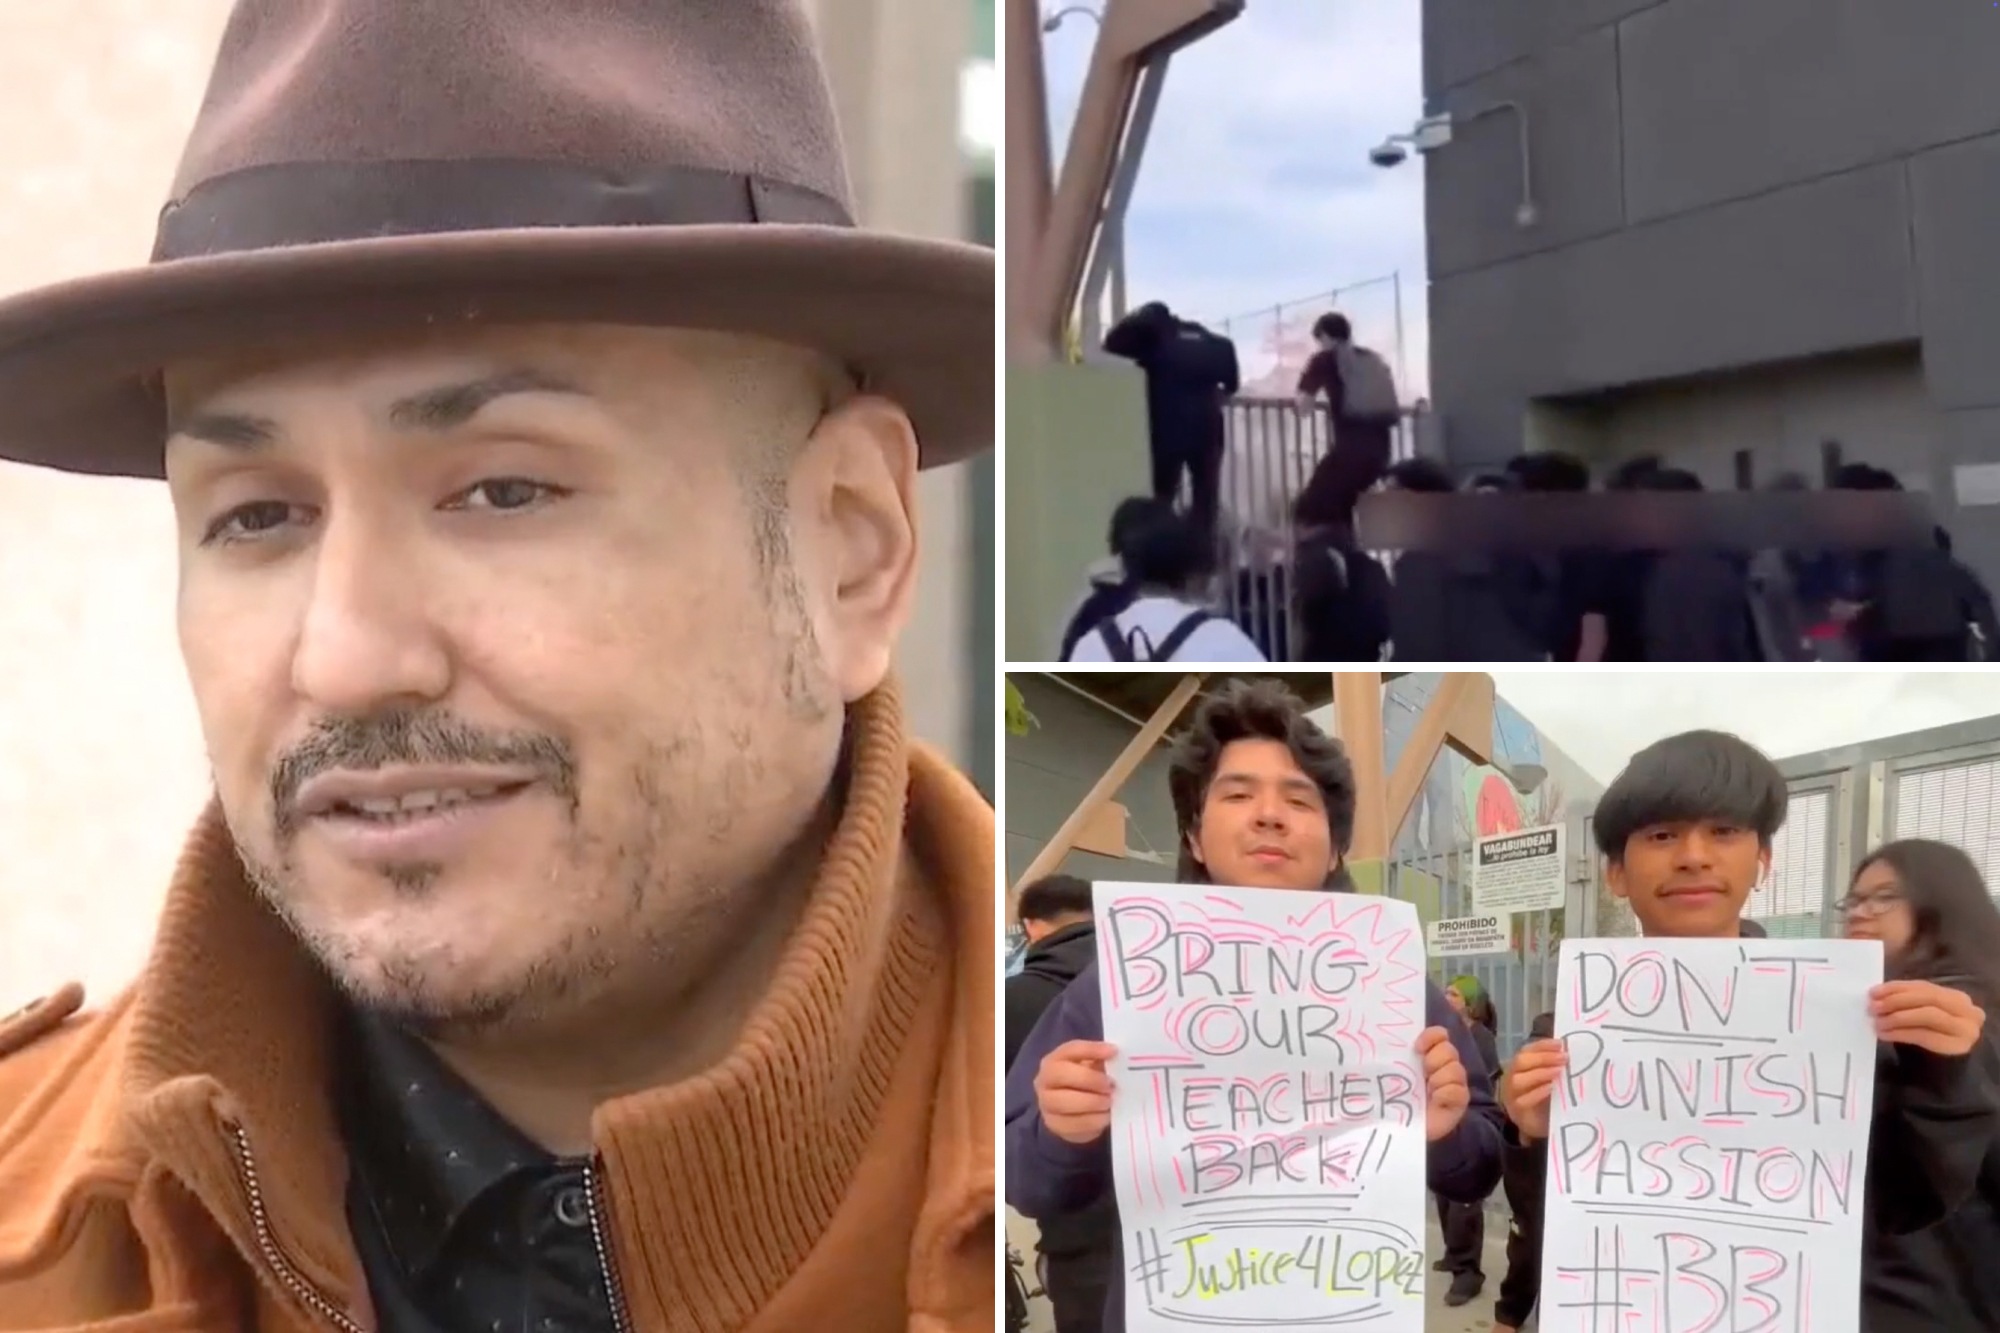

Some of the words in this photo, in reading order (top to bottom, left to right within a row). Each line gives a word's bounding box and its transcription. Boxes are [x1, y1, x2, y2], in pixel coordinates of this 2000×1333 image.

[1483, 833, 1552, 856] VAGABUNDEAR
[1109, 906, 1369, 1000] BRING
[1438, 917, 1497, 932] PROHIBIDO
[1574, 946, 1829, 1033] DON'T
[1188, 1003, 1344, 1063] OUR
[1128, 1064, 1414, 1132] TEACHER
[1561, 1031, 1852, 1125] PUNISH
[1182, 1131, 1392, 1194] BACK!!
[1559, 1121, 1853, 1218] PASSION
